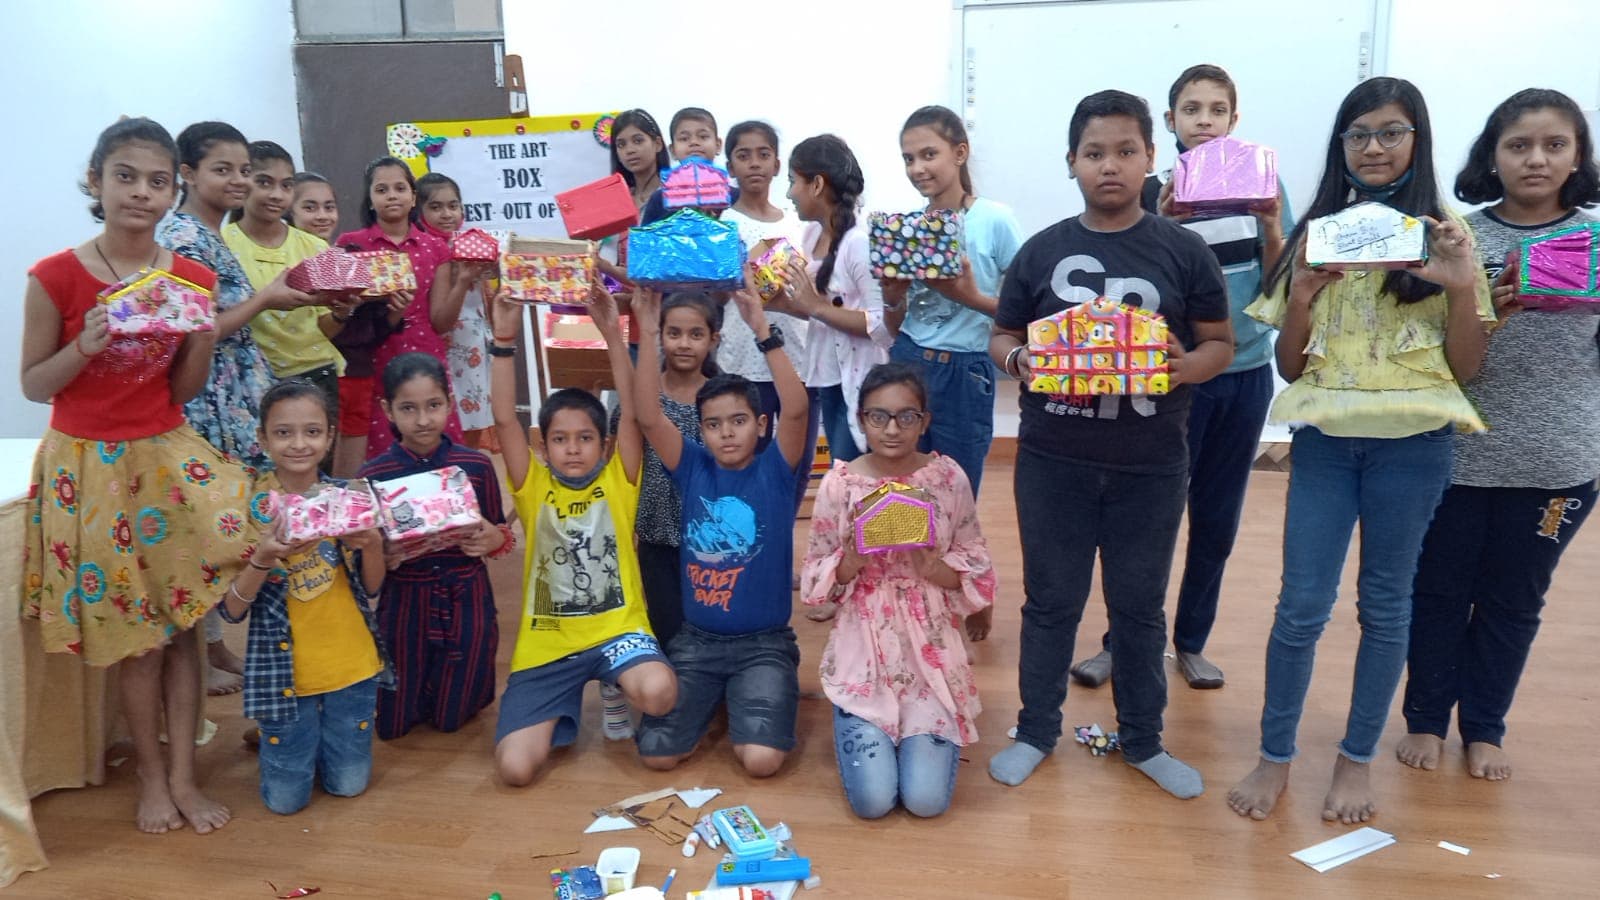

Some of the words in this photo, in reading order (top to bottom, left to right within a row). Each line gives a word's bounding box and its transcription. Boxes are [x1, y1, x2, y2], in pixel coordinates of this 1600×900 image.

[502, 167, 542, 188] BOX
[464, 202, 492, 222] EST
[538, 202, 557, 218] OF
